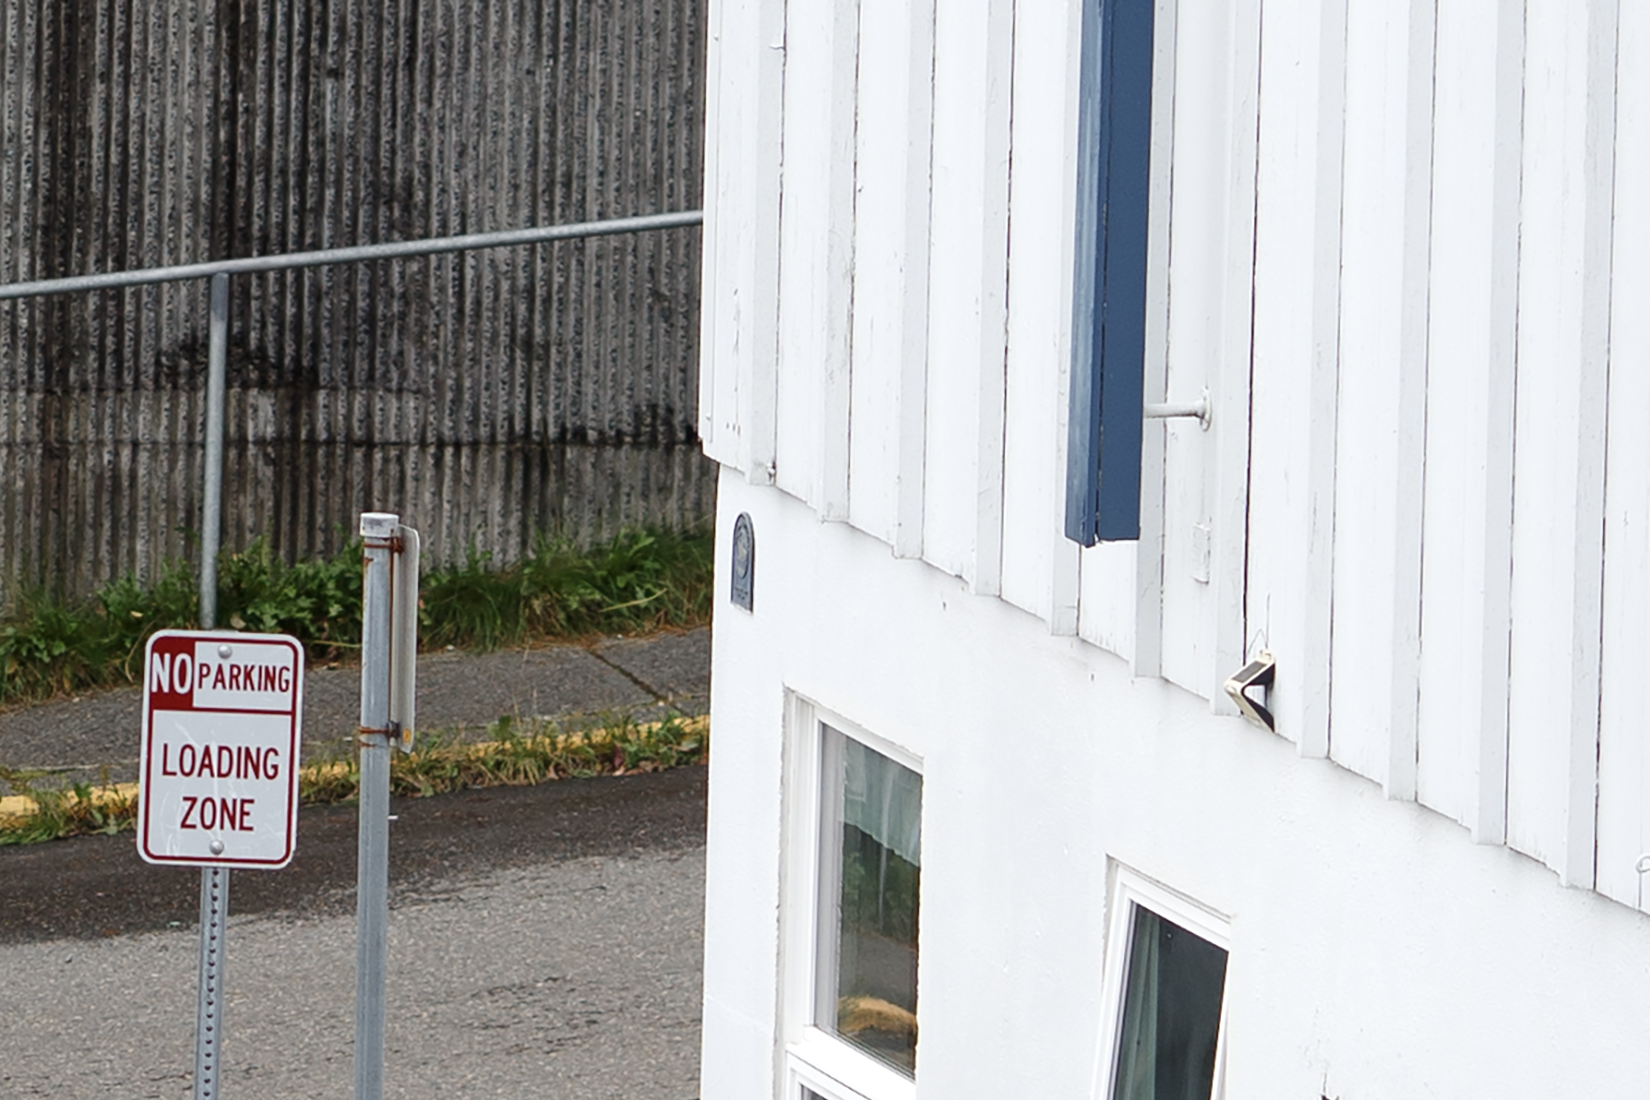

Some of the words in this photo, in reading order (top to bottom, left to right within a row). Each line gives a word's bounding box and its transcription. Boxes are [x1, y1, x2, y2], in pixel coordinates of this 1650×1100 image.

[151, 653, 192, 694] NO
[198, 663, 290, 692] PARKING
[162, 743, 279, 780] LOADING
[180, 796, 255, 831] ZONE
